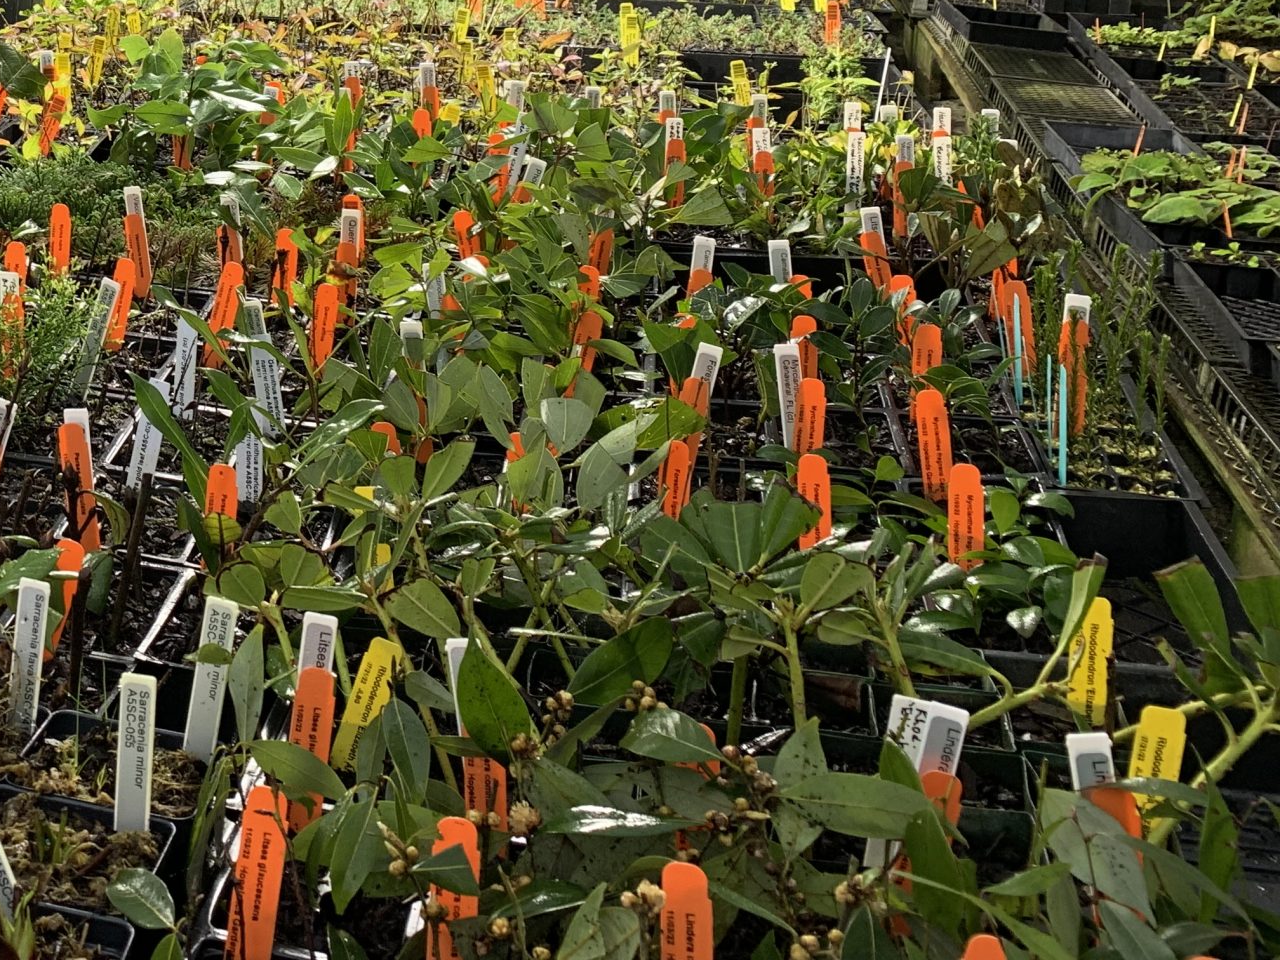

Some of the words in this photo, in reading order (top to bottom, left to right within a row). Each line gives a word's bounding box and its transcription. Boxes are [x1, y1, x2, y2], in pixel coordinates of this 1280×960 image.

[782, 359, 792, 399] Canaveral
[786, 400, 793, 410] FL
[809, 405, 817, 440] Myrcianthes
[966, 495, 974, 534] Myrcianthes
[32, 593, 45, 652] Sarracenia
[28, 652, 38, 674] flava
[316, 631, 332, 670] Litsea
[1087, 623, 1100, 685] Rhododendron
[208, 670, 220, 701] minor
[360, 665, 387, 724] Rhododendron
[125, 688, 137, 748] A5SC-055
[137, 690, 150, 754] Sarracenia
[134, 755, 144, 790] minor
[261, 832, 272, 859] Litsea
[685, 912, 696, 953] Lindera
